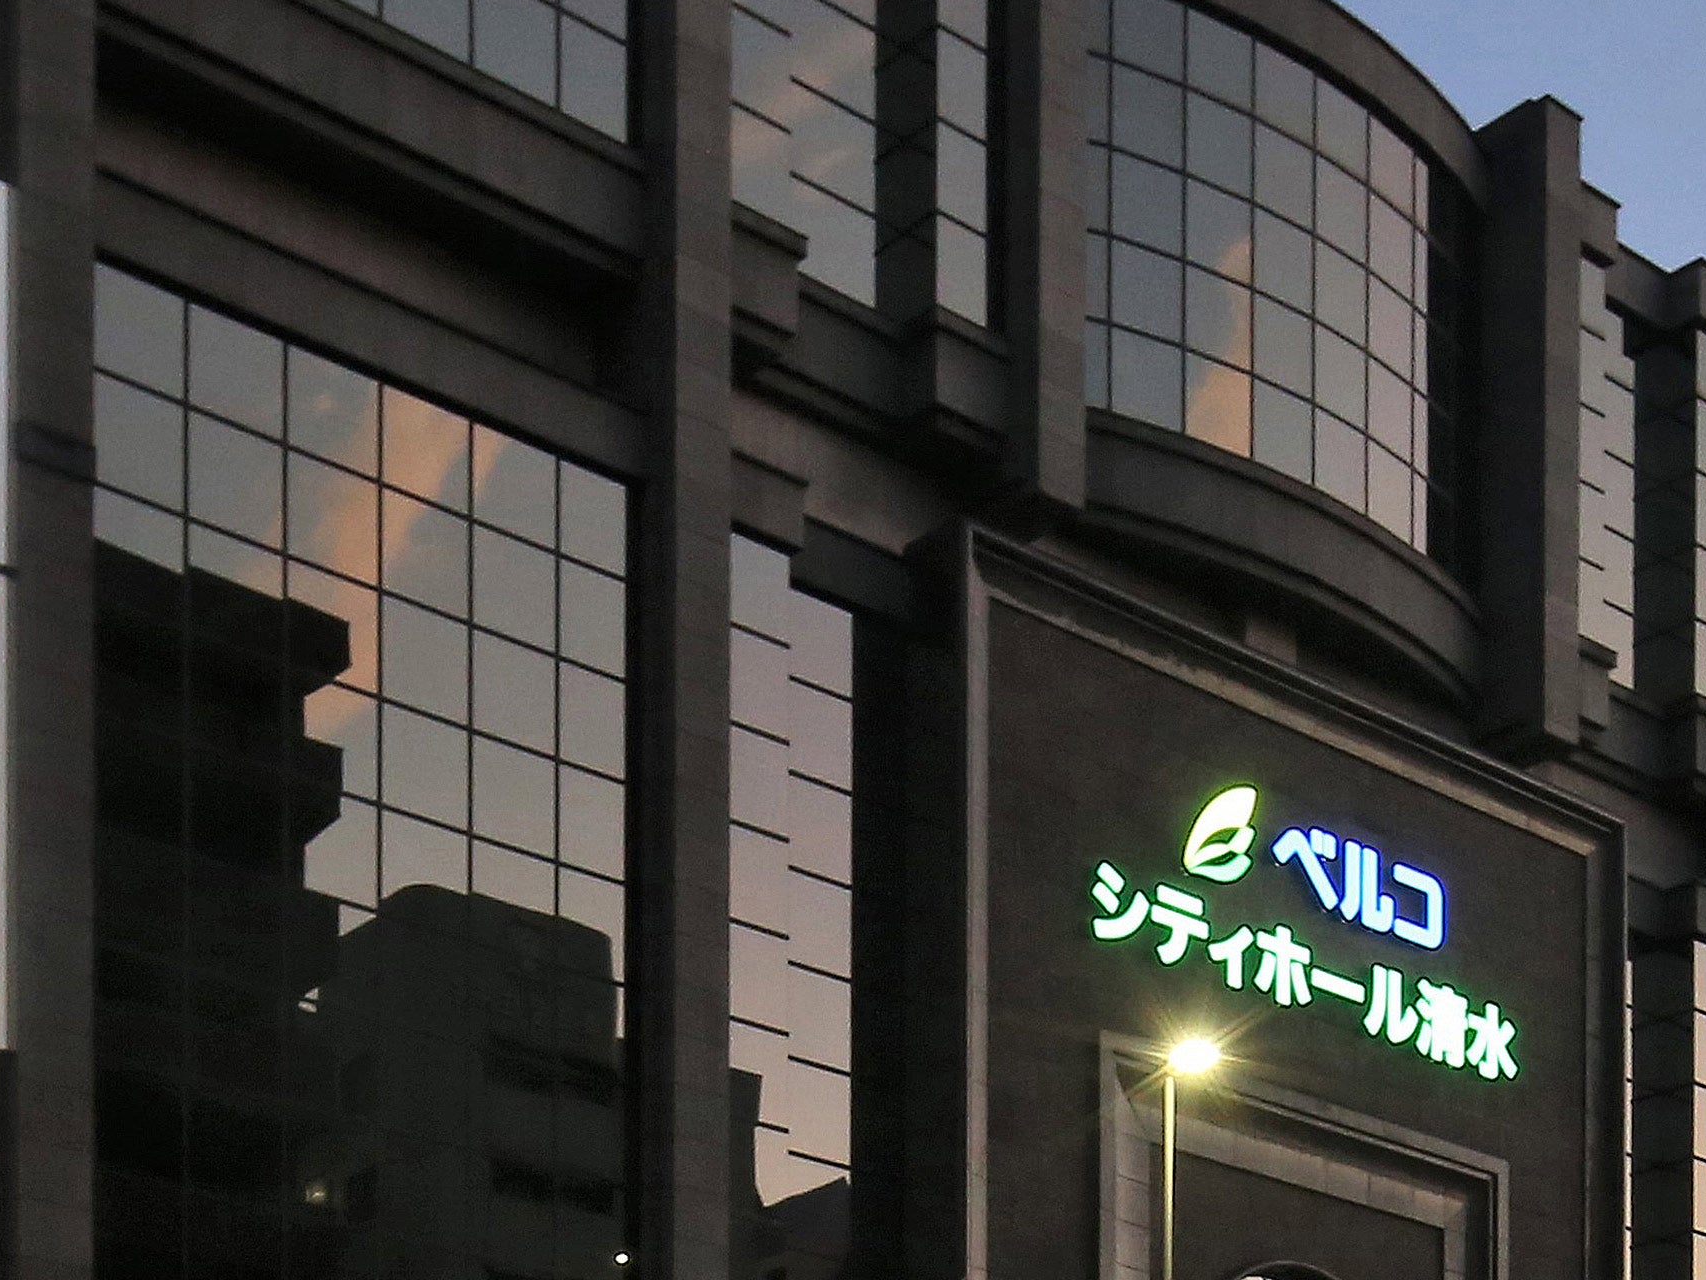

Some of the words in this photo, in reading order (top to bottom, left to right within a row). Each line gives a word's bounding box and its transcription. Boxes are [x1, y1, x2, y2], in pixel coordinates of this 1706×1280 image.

[1090, 862, 1522, 1081] シティホール清水
[1272, 826, 1448, 951] ベルコ
